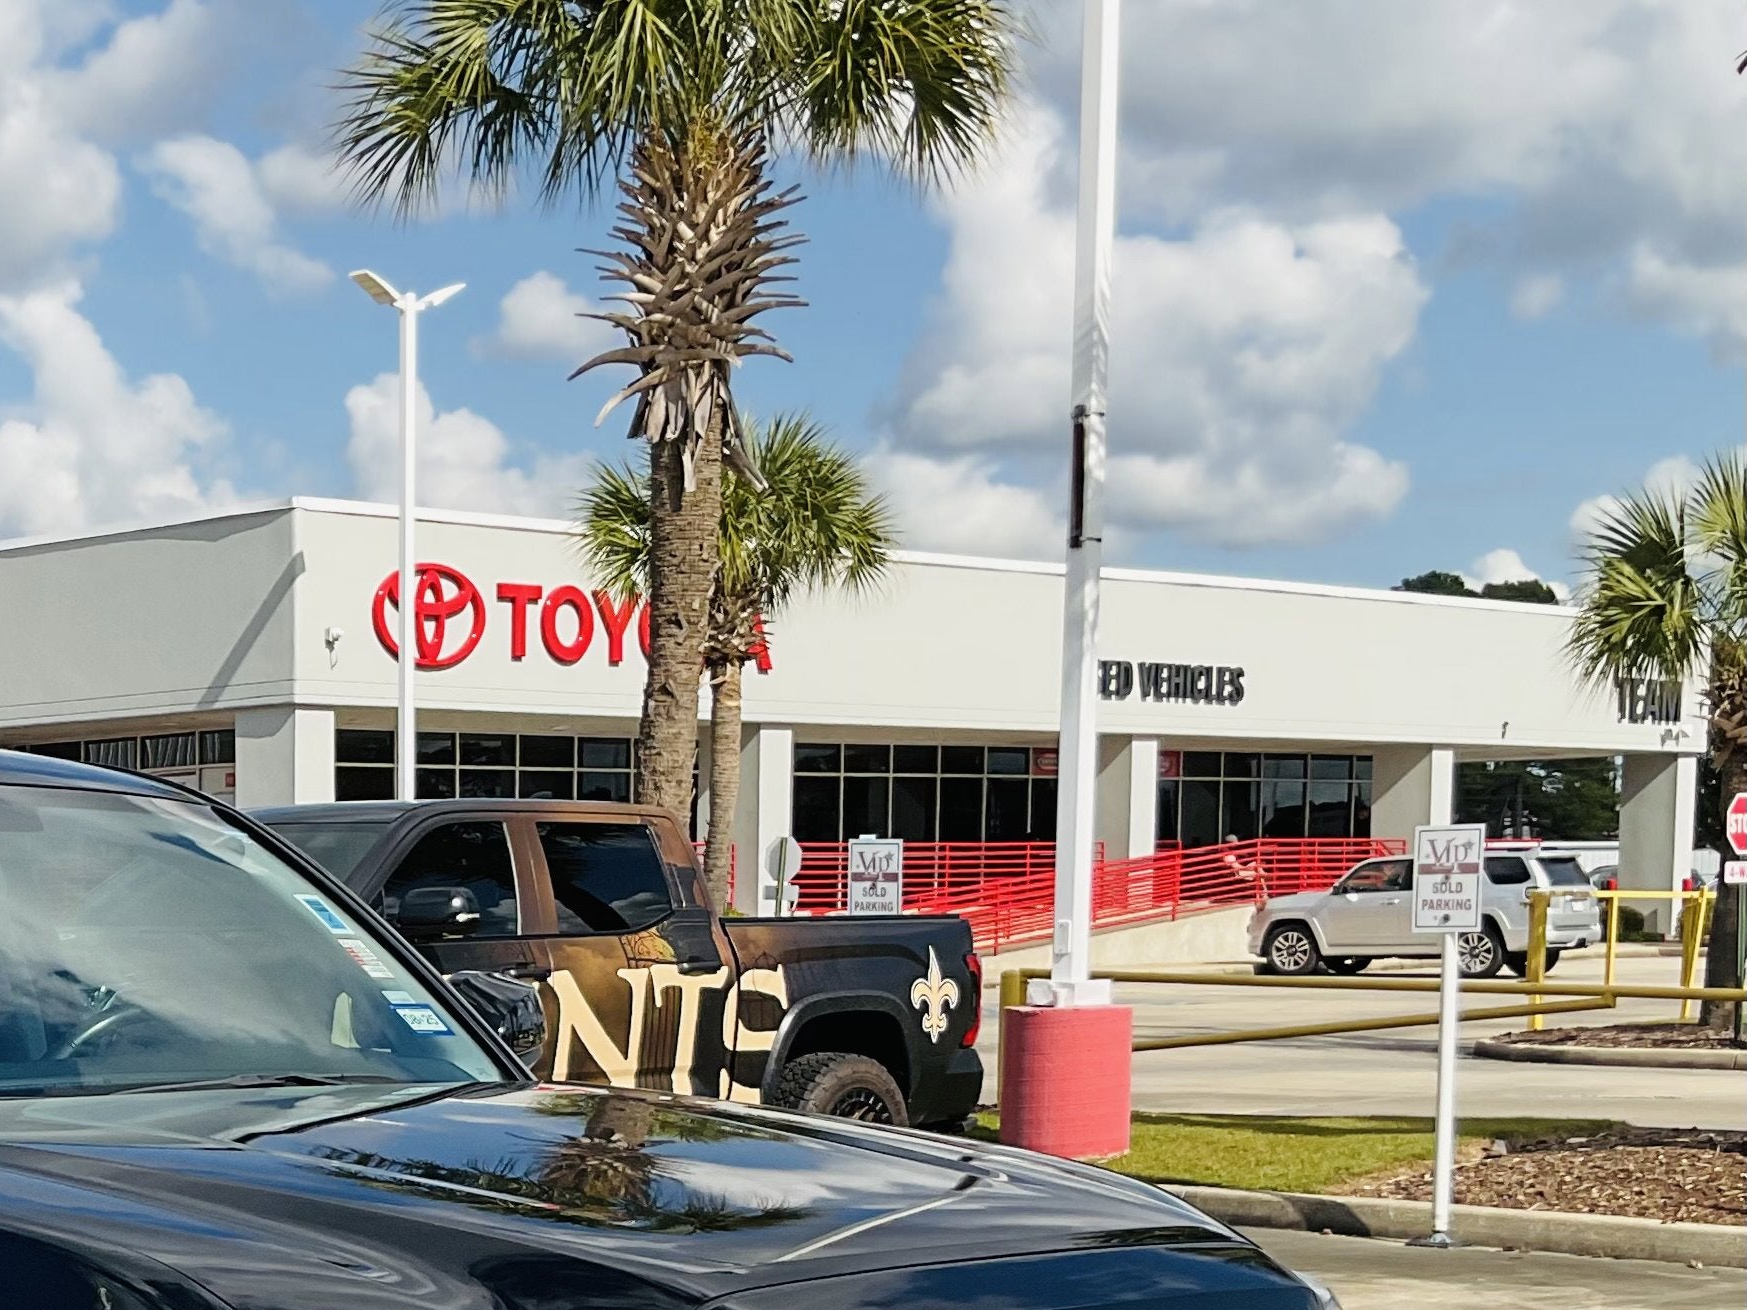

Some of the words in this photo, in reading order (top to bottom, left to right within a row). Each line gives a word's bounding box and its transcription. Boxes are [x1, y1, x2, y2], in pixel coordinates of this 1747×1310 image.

[497, 583, 772, 674] TOY
[1097, 659, 1133, 701] ED
[1137, 662, 1245, 706] VEHICLES
[1614, 678, 1683, 725] TEAM
[862, 887, 887, 897] SOLD
[1432, 882, 1463, 893] SOLD
[854, 901, 894, 912] PARKING
[1421, 899, 1472, 911] PARKING
